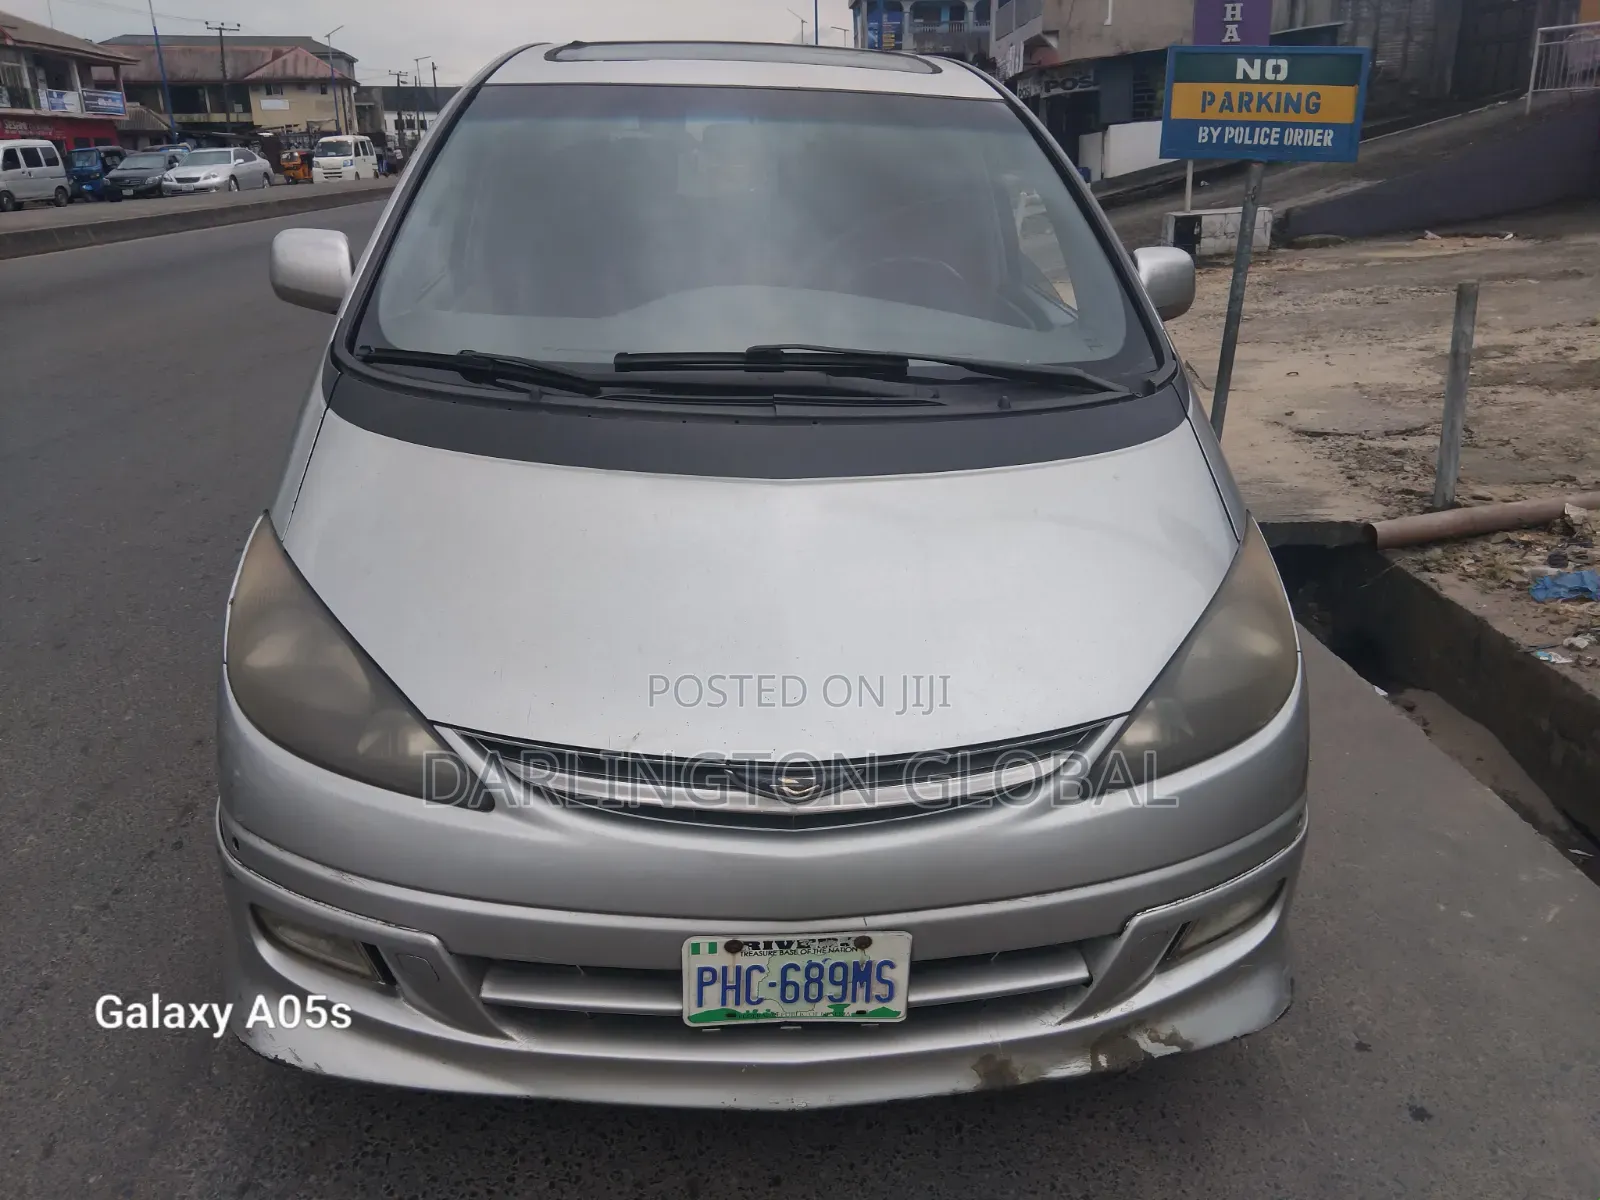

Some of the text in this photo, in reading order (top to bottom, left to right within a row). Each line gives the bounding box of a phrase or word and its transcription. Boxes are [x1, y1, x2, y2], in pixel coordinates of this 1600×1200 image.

[1235, 58, 1289, 81] NO
[1044, 74, 1094, 93] POS
[1200, 90, 1322, 115] PARKING
[1197, 126, 1334, 147] BY POLICE ORDER
[740, 945, 858, 957] TREASURE BASE OF THE NATION
[696, 959, 897, 1008] PHC-689MS
